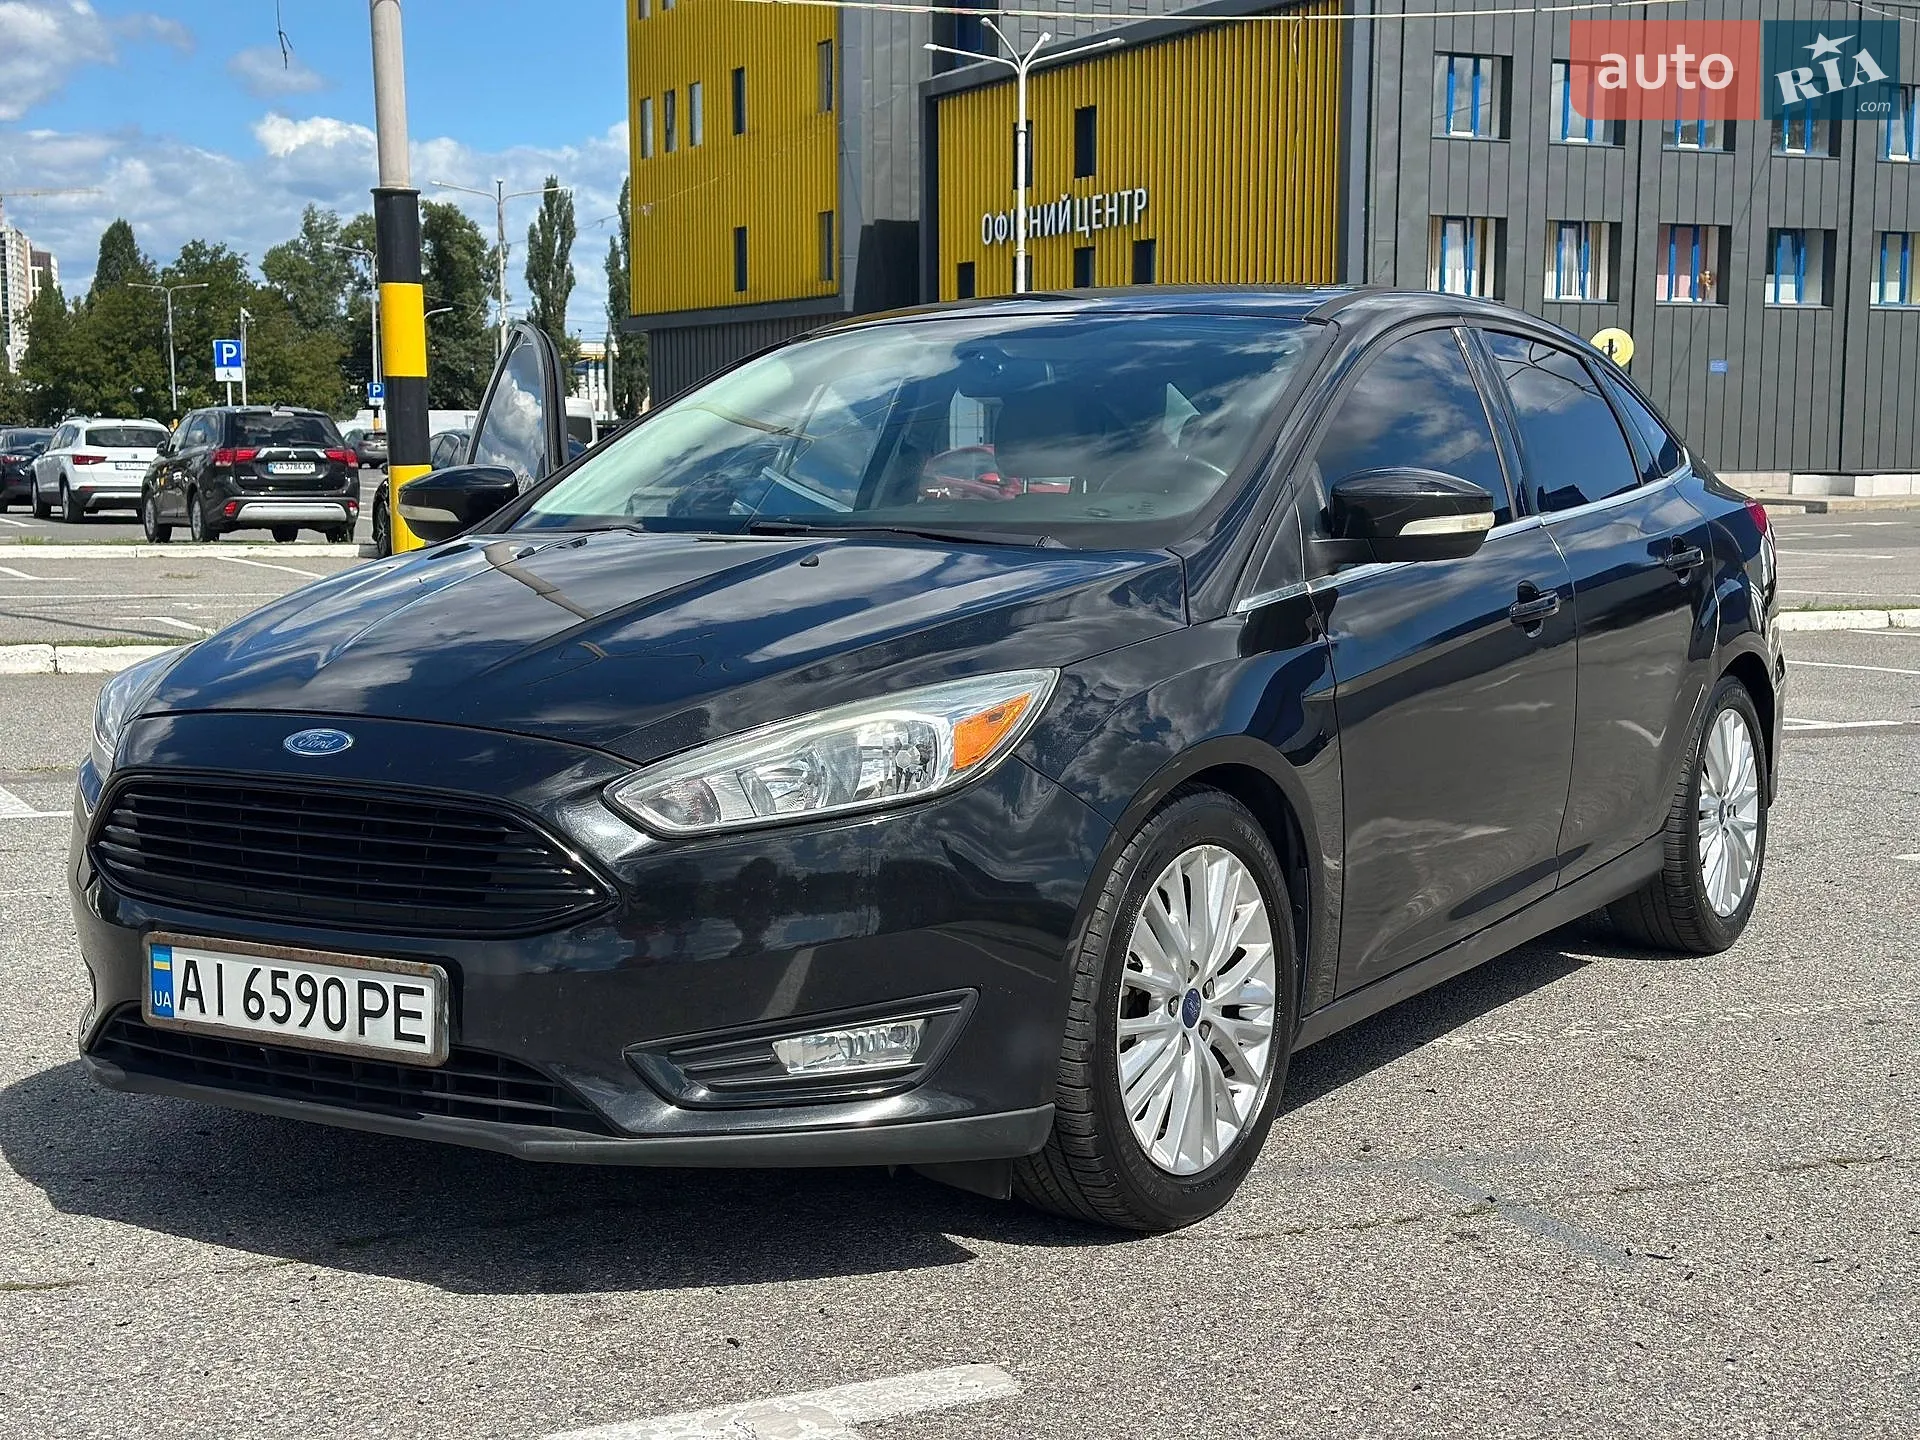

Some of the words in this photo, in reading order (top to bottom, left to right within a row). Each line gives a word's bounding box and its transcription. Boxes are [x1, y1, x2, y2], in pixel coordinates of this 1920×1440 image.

[1075, 187, 1147, 238] ЦЕНТР
[222, 343, 238, 366] P
[372, 384, 382, 397] P
[298, 733, 340, 749] Ford
[154, 990, 172, 1009] UA
